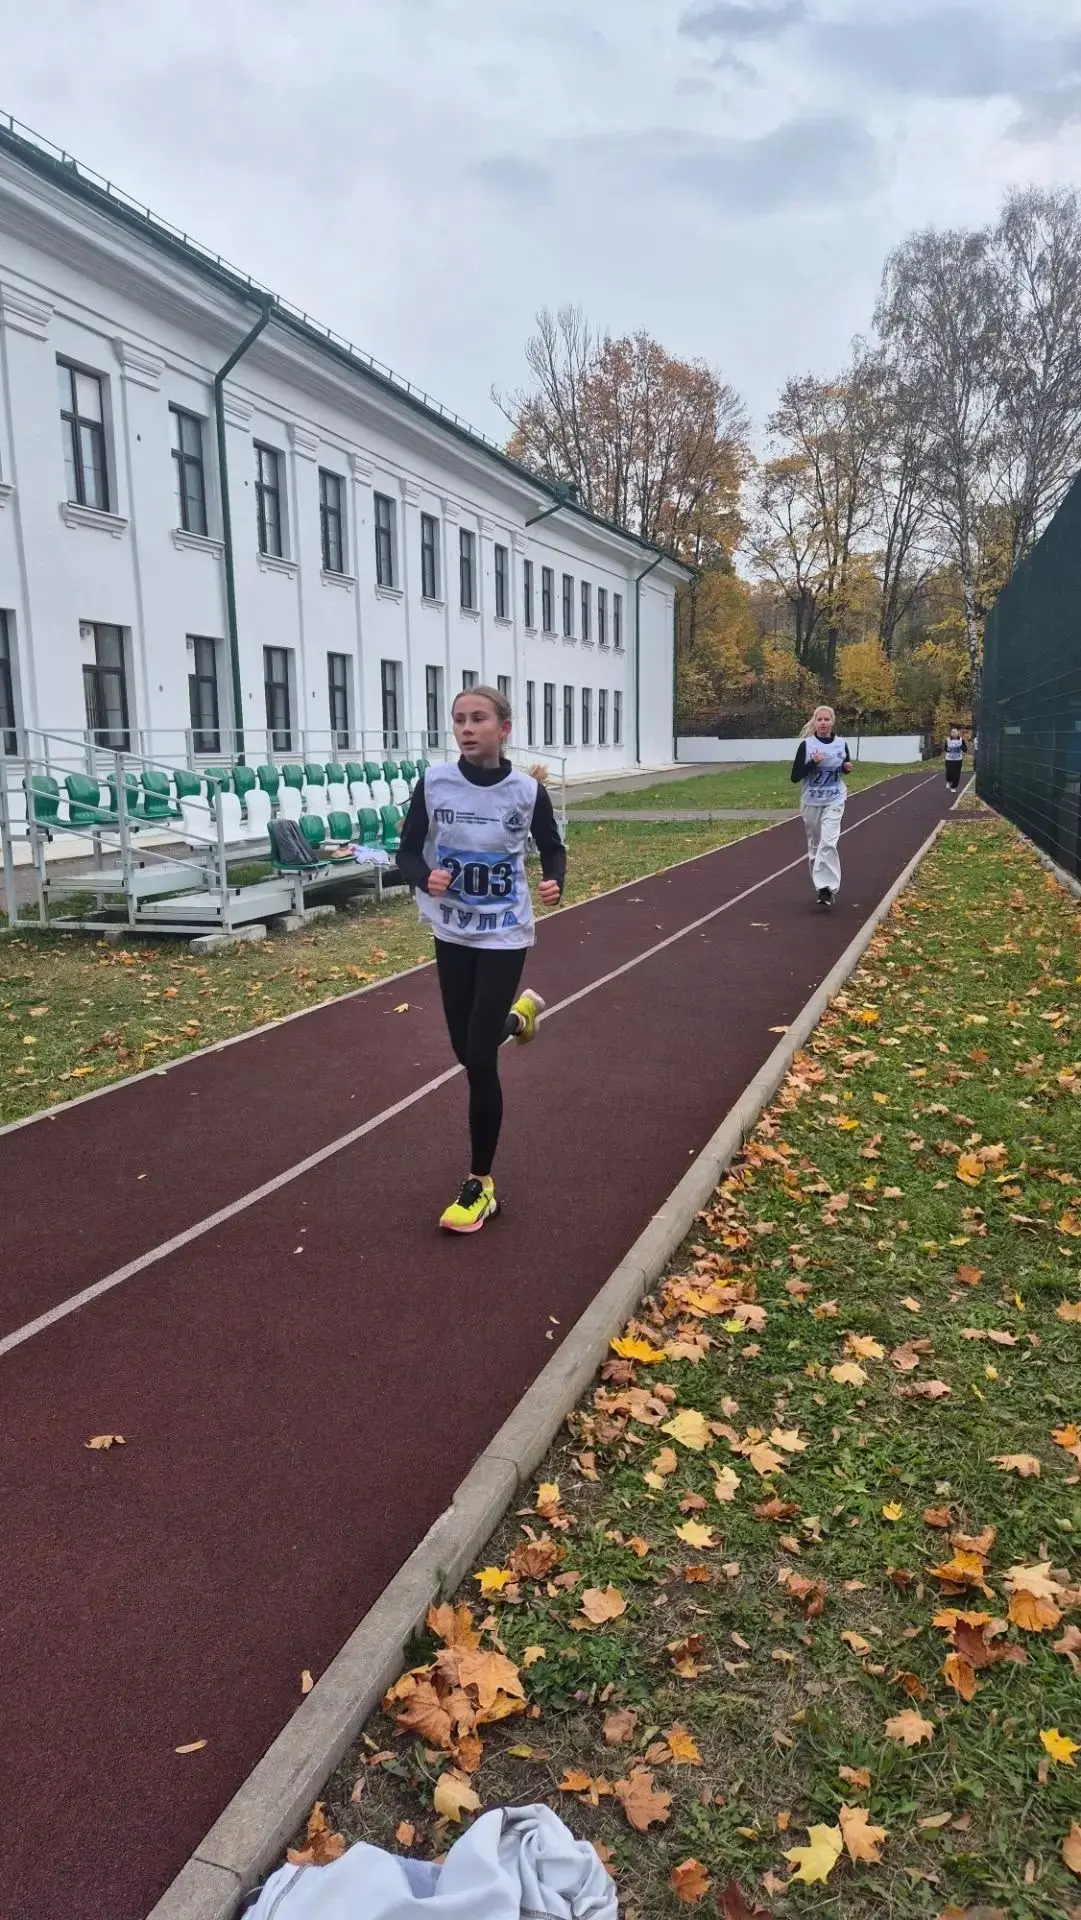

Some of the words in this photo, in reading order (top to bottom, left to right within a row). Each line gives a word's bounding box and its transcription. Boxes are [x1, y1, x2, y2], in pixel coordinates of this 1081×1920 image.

[433, 808, 455, 825] ГТО
[440, 857, 514, 897] 203
[440, 904, 520, 931] ТУЛА
